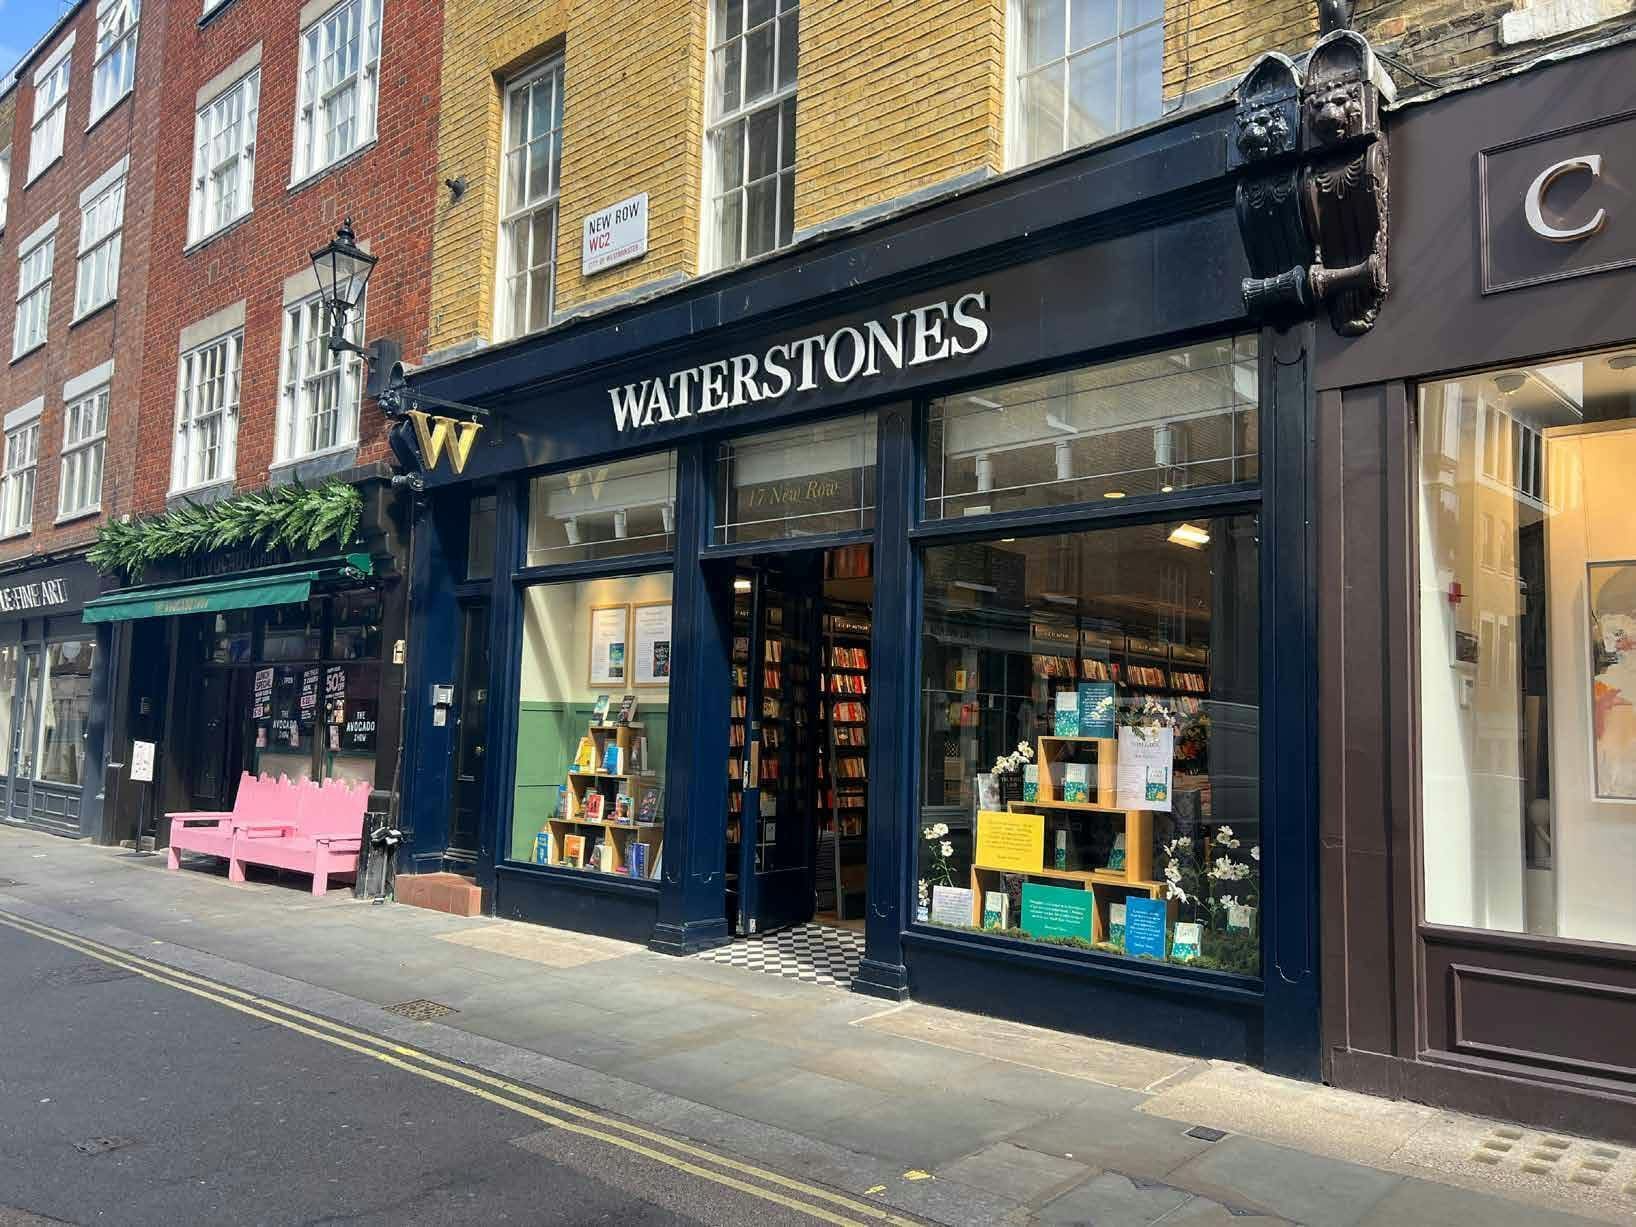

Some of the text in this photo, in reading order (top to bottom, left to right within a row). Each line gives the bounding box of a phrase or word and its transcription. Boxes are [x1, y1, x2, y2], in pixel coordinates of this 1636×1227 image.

[1525, 154, 1607, 241] C
[589, 201, 640, 235] NEW ROW
[589, 232, 610, 253] WC2
[606, 244, 639, 261] WESTMINSTER
[607, 290, 990, 432] WATERSTONES
[405, 409, 483, 474] W
[41, 578, 66, 606] ART
[272, 719, 298, 729] AVOCADO
[356, 711, 366, 719] THE
[346, 721, 376, 732] AVOCADO
[353, 733, 367, 742] SHOW
